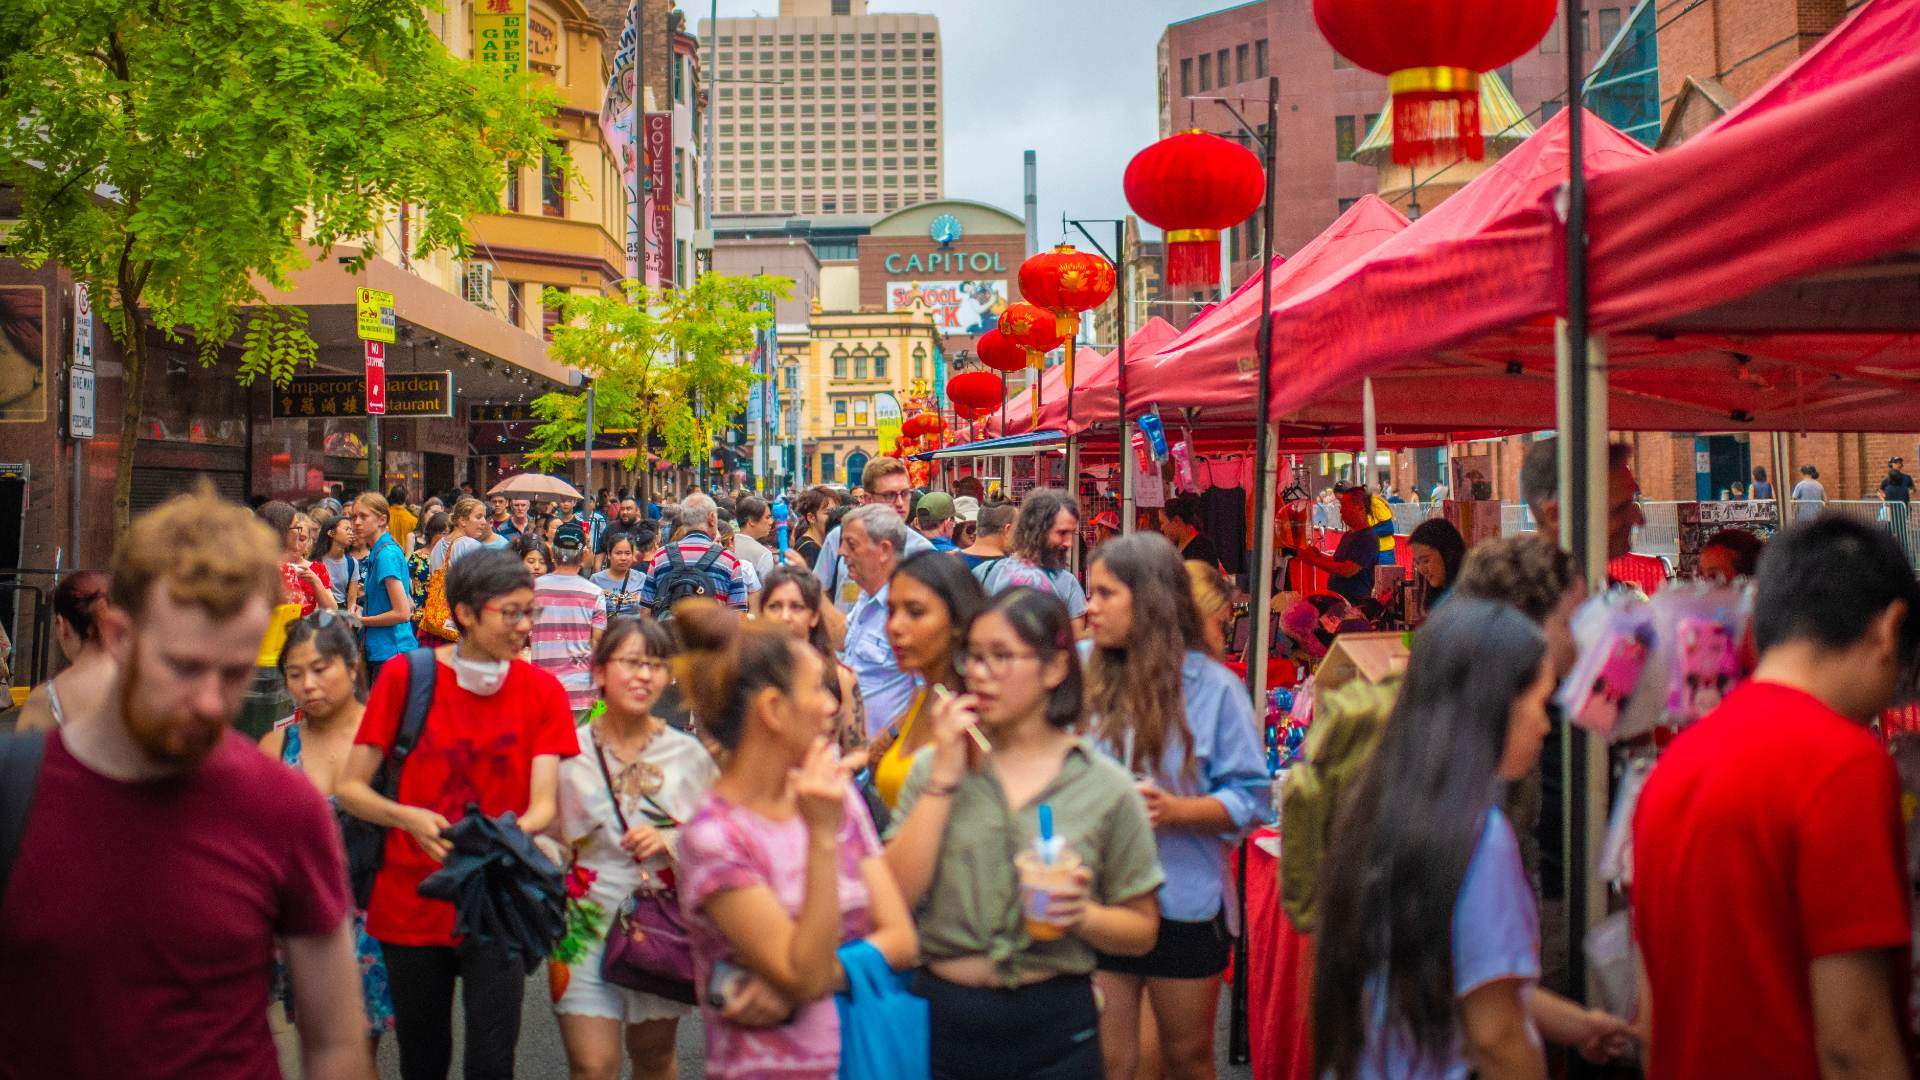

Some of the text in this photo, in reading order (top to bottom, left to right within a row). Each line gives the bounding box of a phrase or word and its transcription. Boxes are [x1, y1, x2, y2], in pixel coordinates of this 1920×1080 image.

[651, 117, 665, 200] COVENT
[885, 251, 1007, 274] CAPITOL
[371, 342, 379, 355] NO
[72, 375, 93, 392] GIVE WAY
